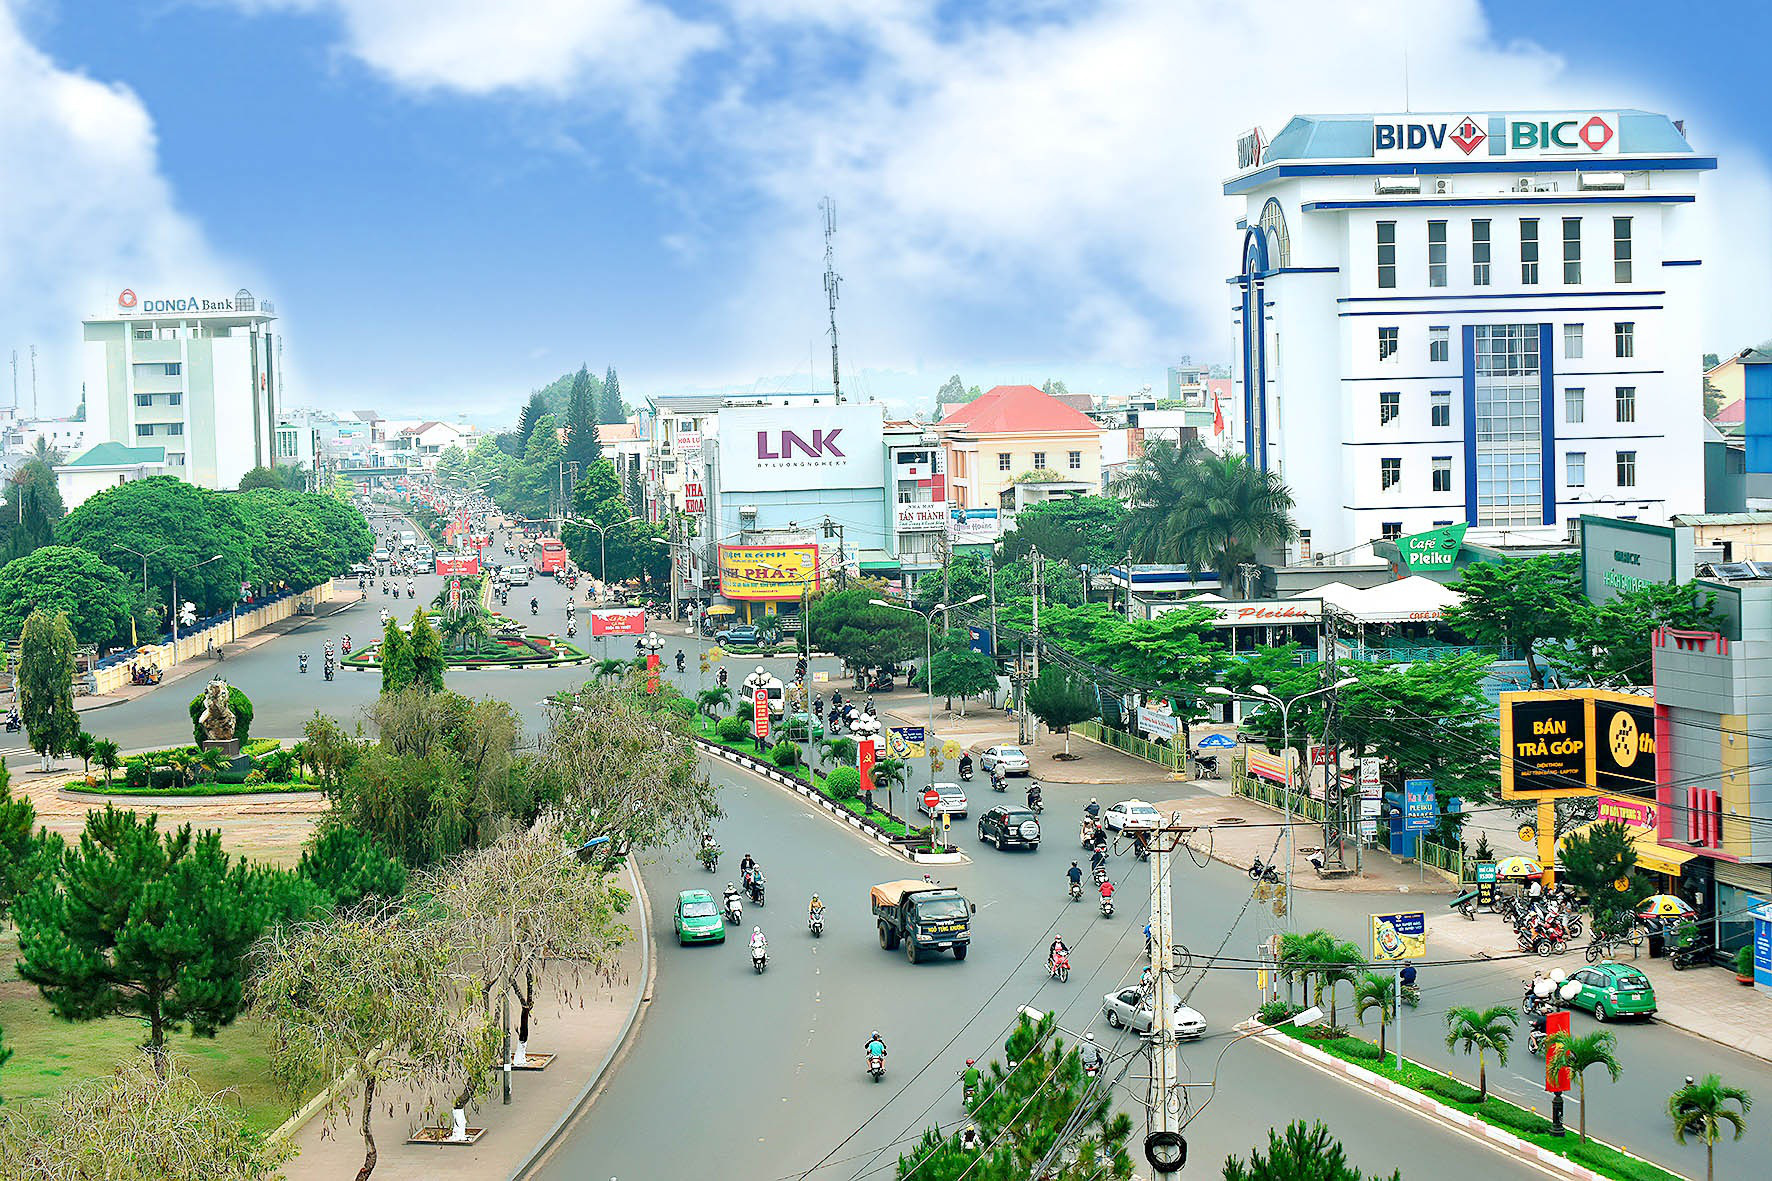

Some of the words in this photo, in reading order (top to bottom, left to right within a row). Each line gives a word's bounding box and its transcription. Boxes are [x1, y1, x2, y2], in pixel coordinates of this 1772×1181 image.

[1375, 124, 1447, 150] BIDV
[143, 297, 200, 312] DONGA
[202, 299, 234, 311] Bank
[757, 428, 846, 459] LNK
[685, 499, 705, 512] KHOA
[1409, 538, 1437, 552] Café
[1409, 552, 1452, 564] Pleiku
[744, 564, 798, 579] PHÁT
[1238, 607, 1307, 619] Pleiku
[1533, 717, 1567, 735] BÁN
[1516, 737, 1549, 757] TRẢ
[1550, 737, 1584, 755] GÓP
